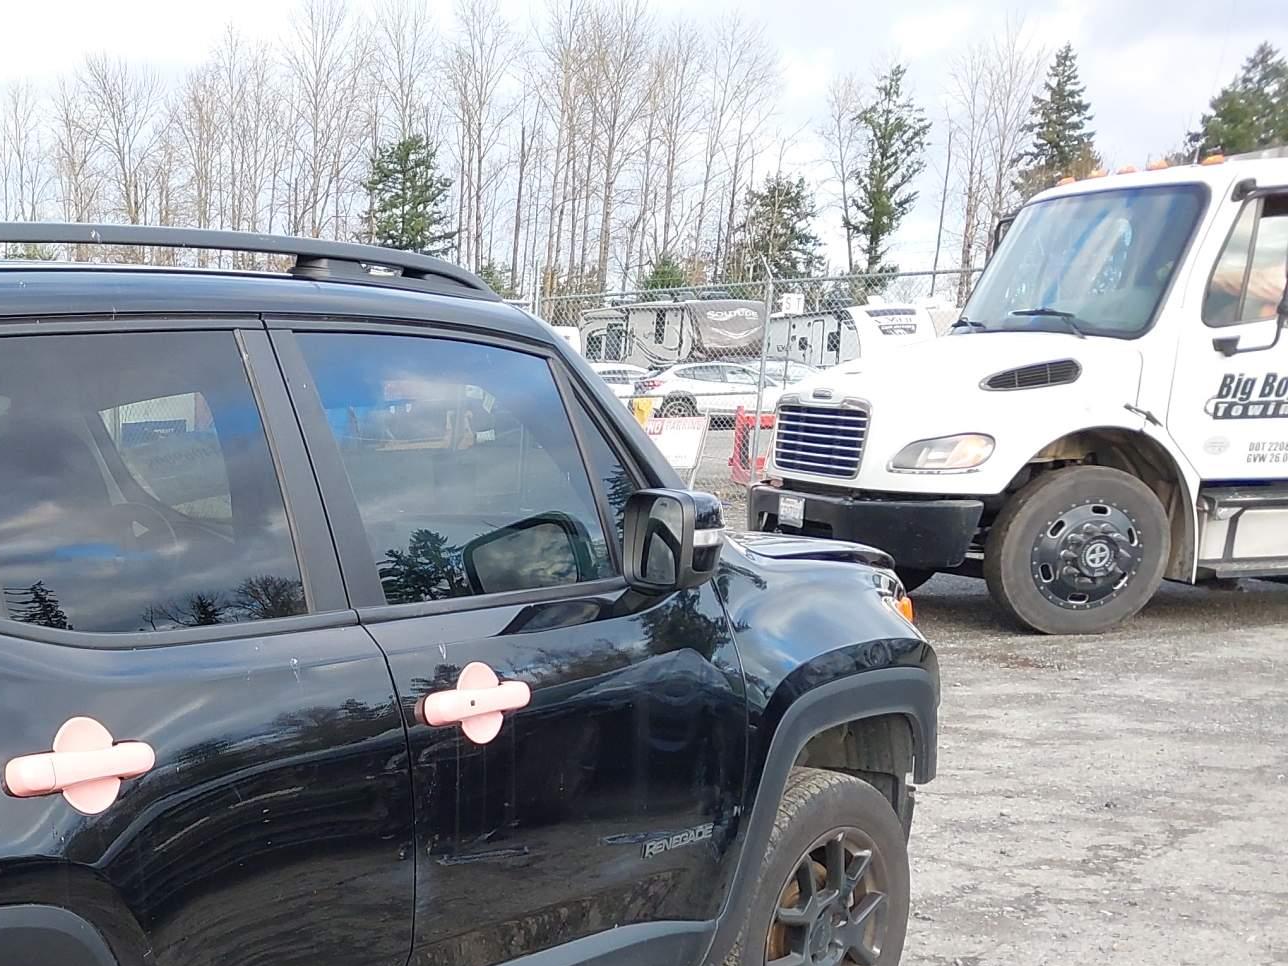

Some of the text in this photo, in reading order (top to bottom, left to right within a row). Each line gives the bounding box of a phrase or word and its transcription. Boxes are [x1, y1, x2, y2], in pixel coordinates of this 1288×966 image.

[1216, 372, 1288, 402] Big Bo
[647, 420, 662, 434] NO
[1249, 442, 1267, 452] DOT
[1247, 454, 1268, 463] GVW
[640, 822, 714, 859] RENEGADE
